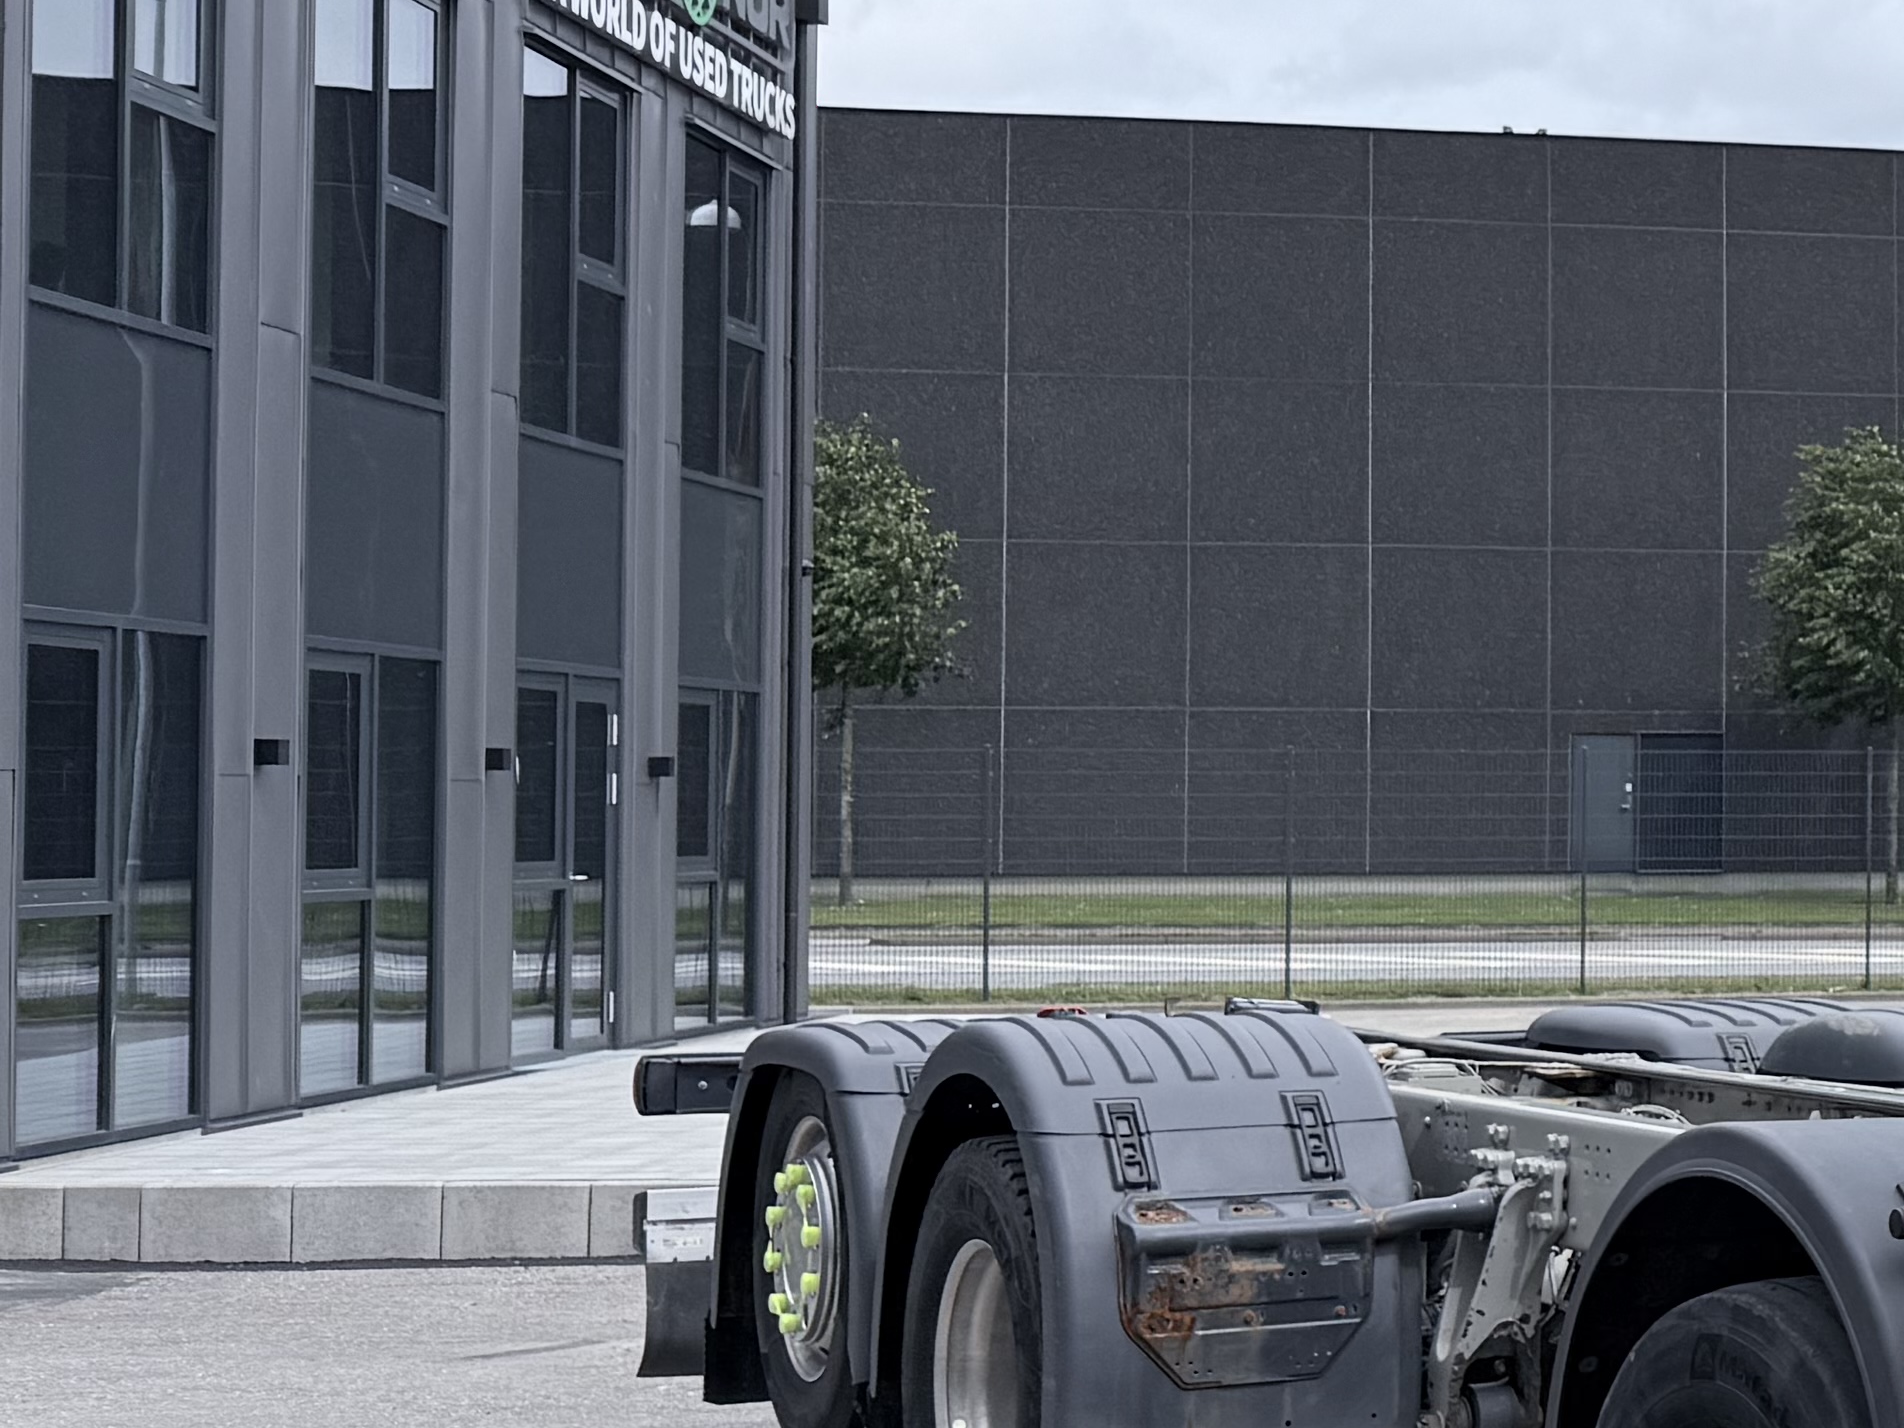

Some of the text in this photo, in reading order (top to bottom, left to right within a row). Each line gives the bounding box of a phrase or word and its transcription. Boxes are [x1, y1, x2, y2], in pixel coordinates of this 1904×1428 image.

[649, 9, 677, 68] OF
[678, 27, 729, 99] USED
[731, 58, 796, 140] TRUCKS
